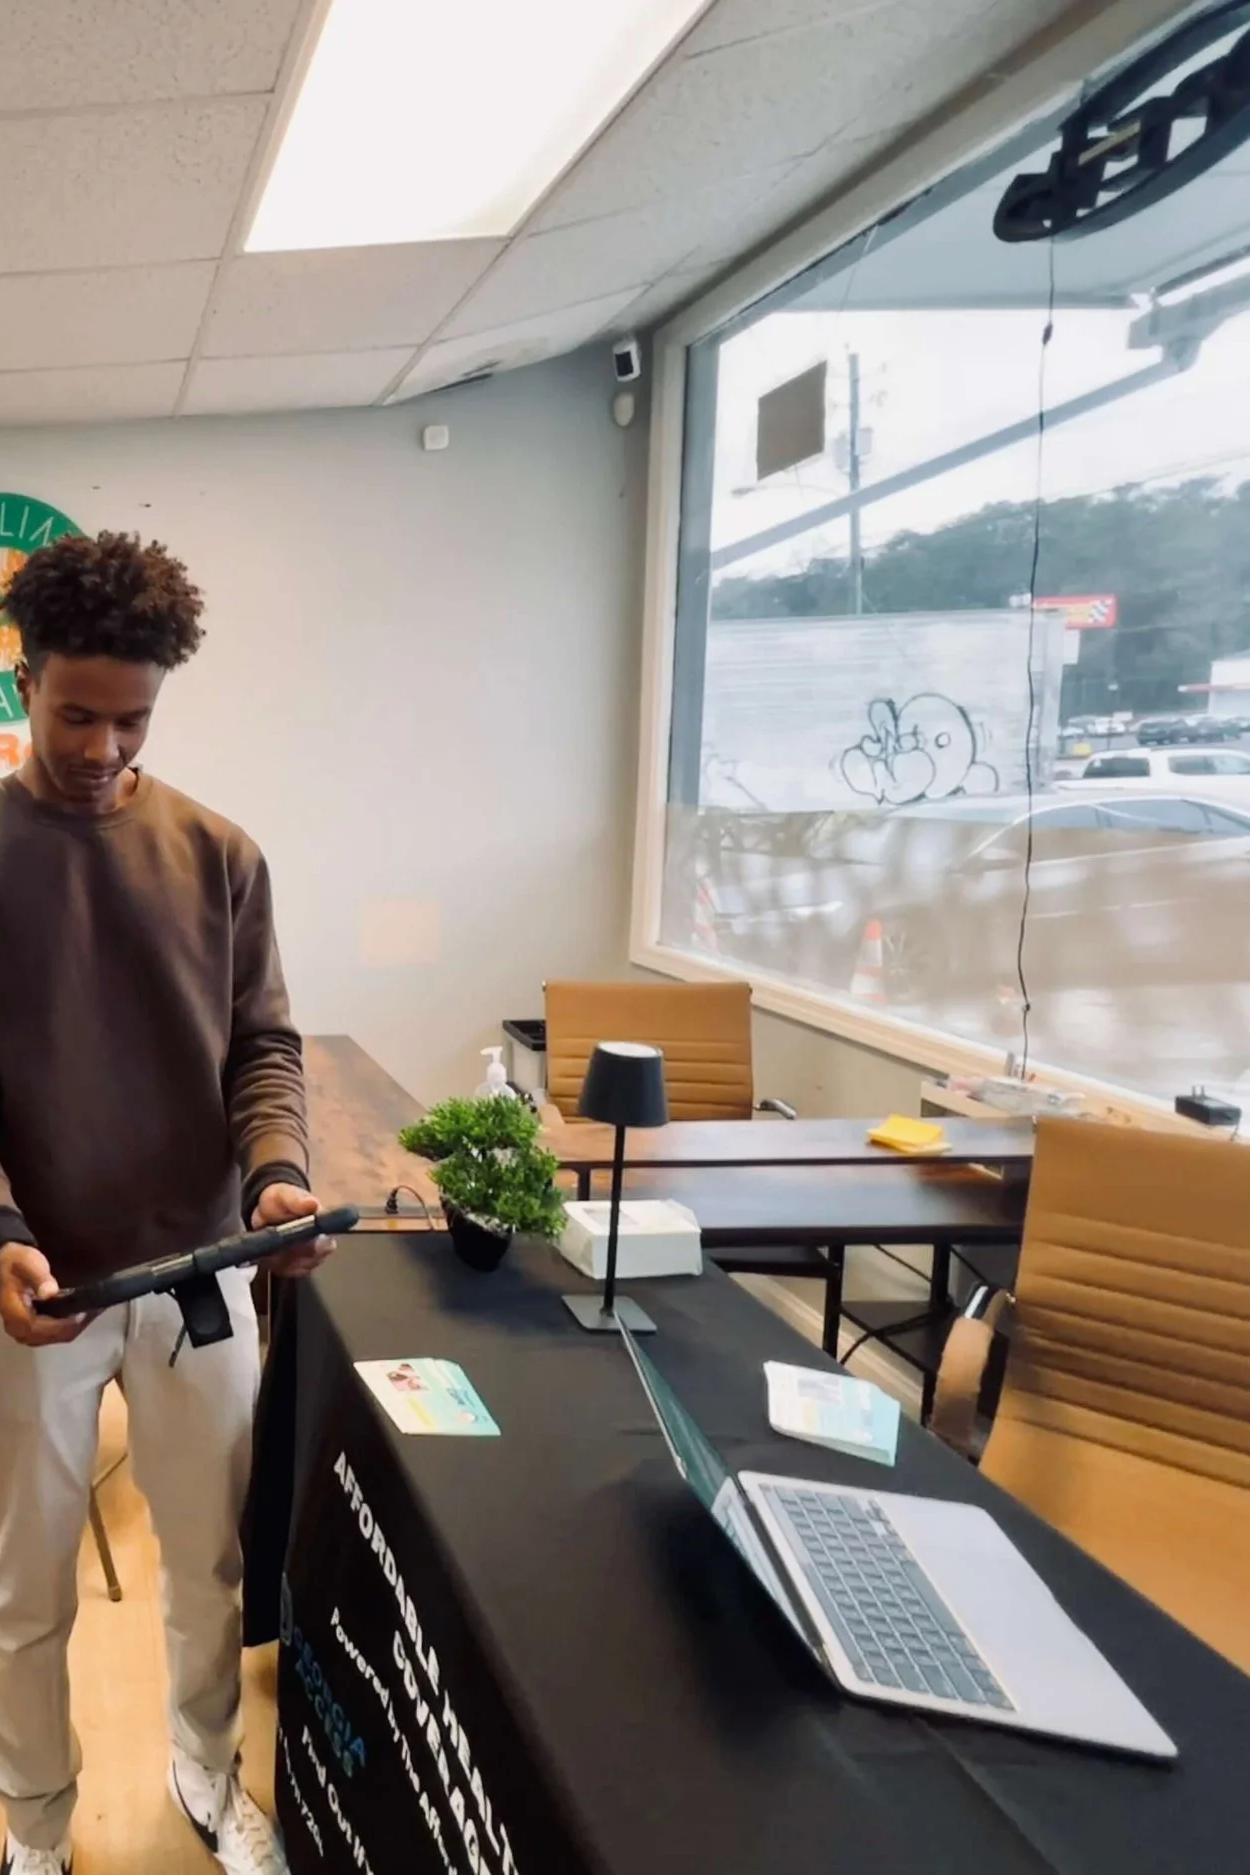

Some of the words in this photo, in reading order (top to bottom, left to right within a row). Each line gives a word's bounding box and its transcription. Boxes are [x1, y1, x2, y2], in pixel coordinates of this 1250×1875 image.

[330, 1606, 389, 1708] Powered
[335, 1451, 439, 1696] AFFORDABLE
[443, 1690, 519, 1875] HEALT
